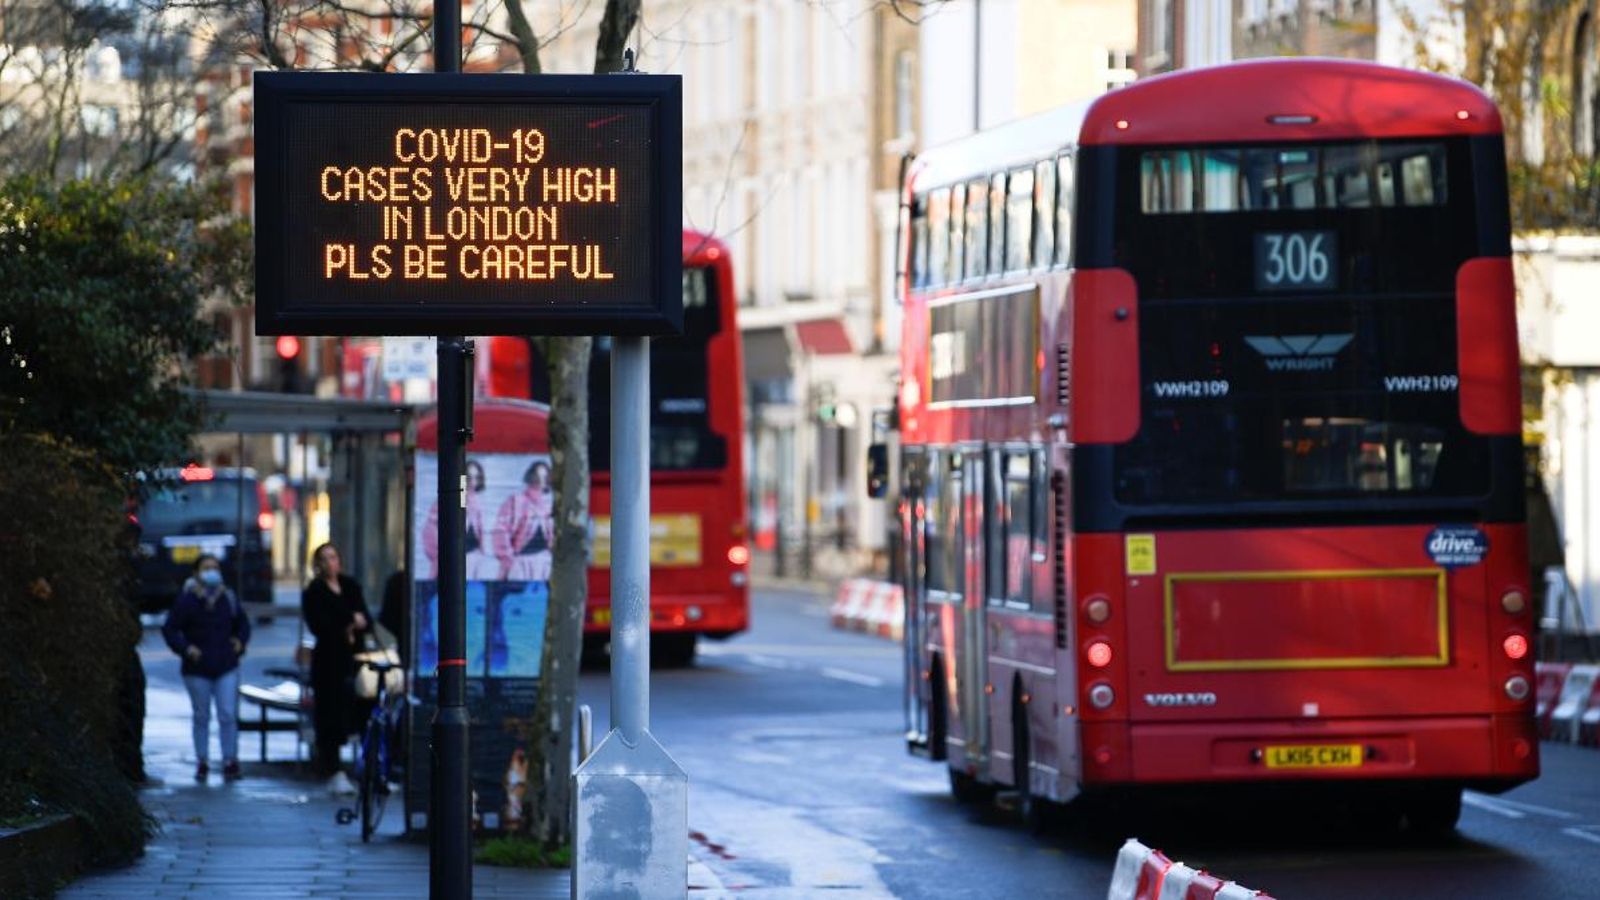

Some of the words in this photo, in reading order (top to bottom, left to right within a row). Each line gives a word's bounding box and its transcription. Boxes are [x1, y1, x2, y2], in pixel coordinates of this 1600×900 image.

[395, 128, 545, 164] COVID-19
[321, 166, 433, 201] CASES
[444, 167, 531, 202] VERY
[542, 167, 616, 202] HIGH
[383, 206, 413, 240] IN
[424, 206, 558, 240] LONDON
[325, 244, 393, 279] PLS
[403, 244, 448, 279] BE
[459, 244, 614, 279] CAREFUL
[1265, 233, 1328, 283] 306
[1265, 357, 1335, 370] WRIGHT
[1154, 380, 1229, 397] VWH2109
[1384, 375, 1459, 392] VWH2109
[1144, 692, 1217, 707] VOLVO
[1318, 747, 1352, 764] CXH
